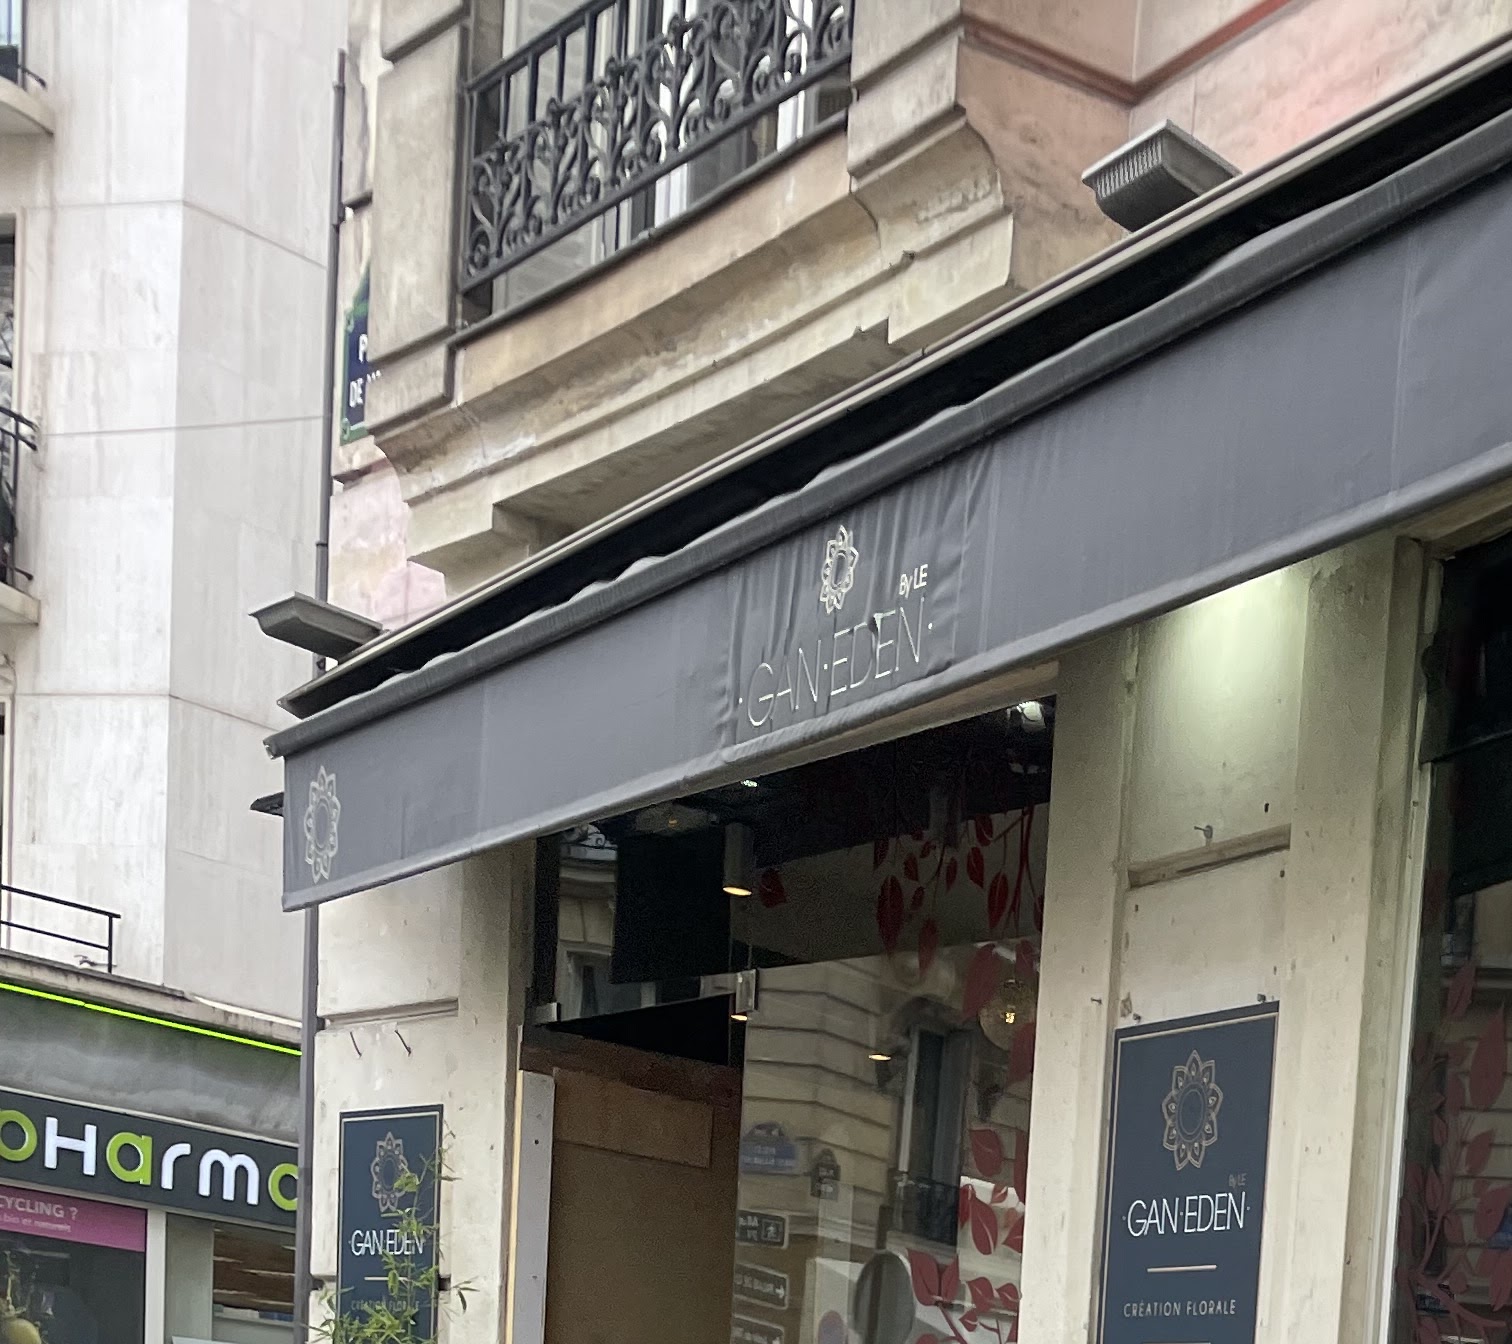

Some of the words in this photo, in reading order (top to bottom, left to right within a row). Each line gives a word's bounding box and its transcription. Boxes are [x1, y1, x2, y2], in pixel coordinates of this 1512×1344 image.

[913, 563, 929, 590] LE
[1184, 1191, 1246, 1233] EDEN
[1186, 1299, 1237, 1316] FLORALE
